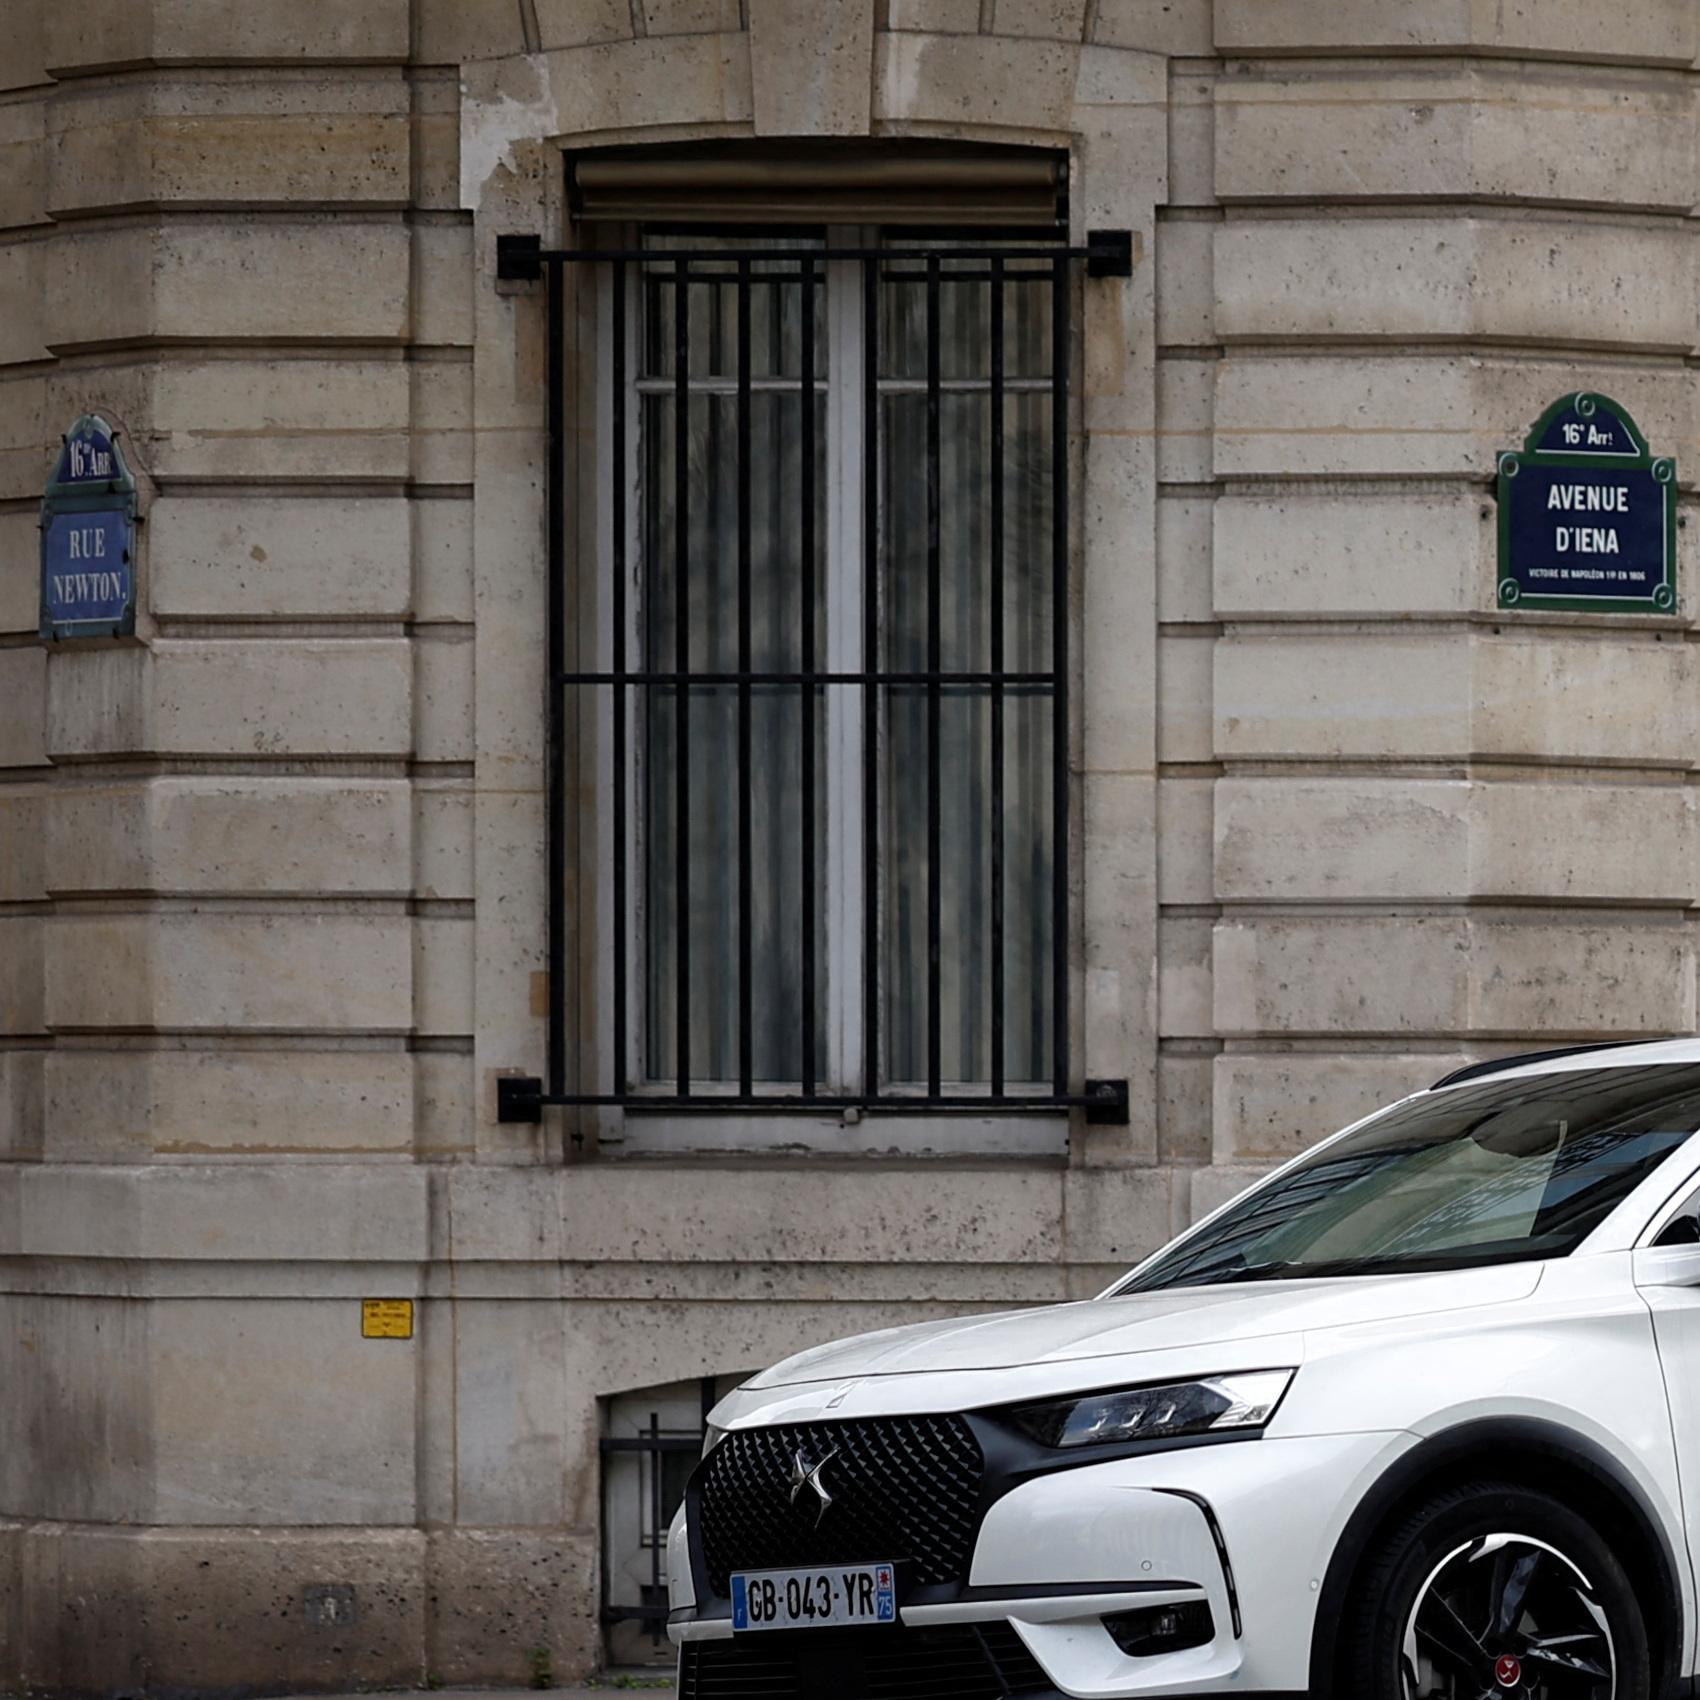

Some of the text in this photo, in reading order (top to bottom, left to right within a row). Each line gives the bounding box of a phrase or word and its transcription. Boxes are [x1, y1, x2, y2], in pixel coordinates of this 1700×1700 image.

[1547, 484, 1629, 512] AVENUE
[69, 528, 105, 559] RUE
[1556, 527, 1619, 554] D'IENA
[1528, 568, 1559, 578] VICTOIRE
[1561, 569, 1569, 578] DE
[749, 1573, 875, 1622] GB-043-YR
[878, 1596, 892, 1616] 75
